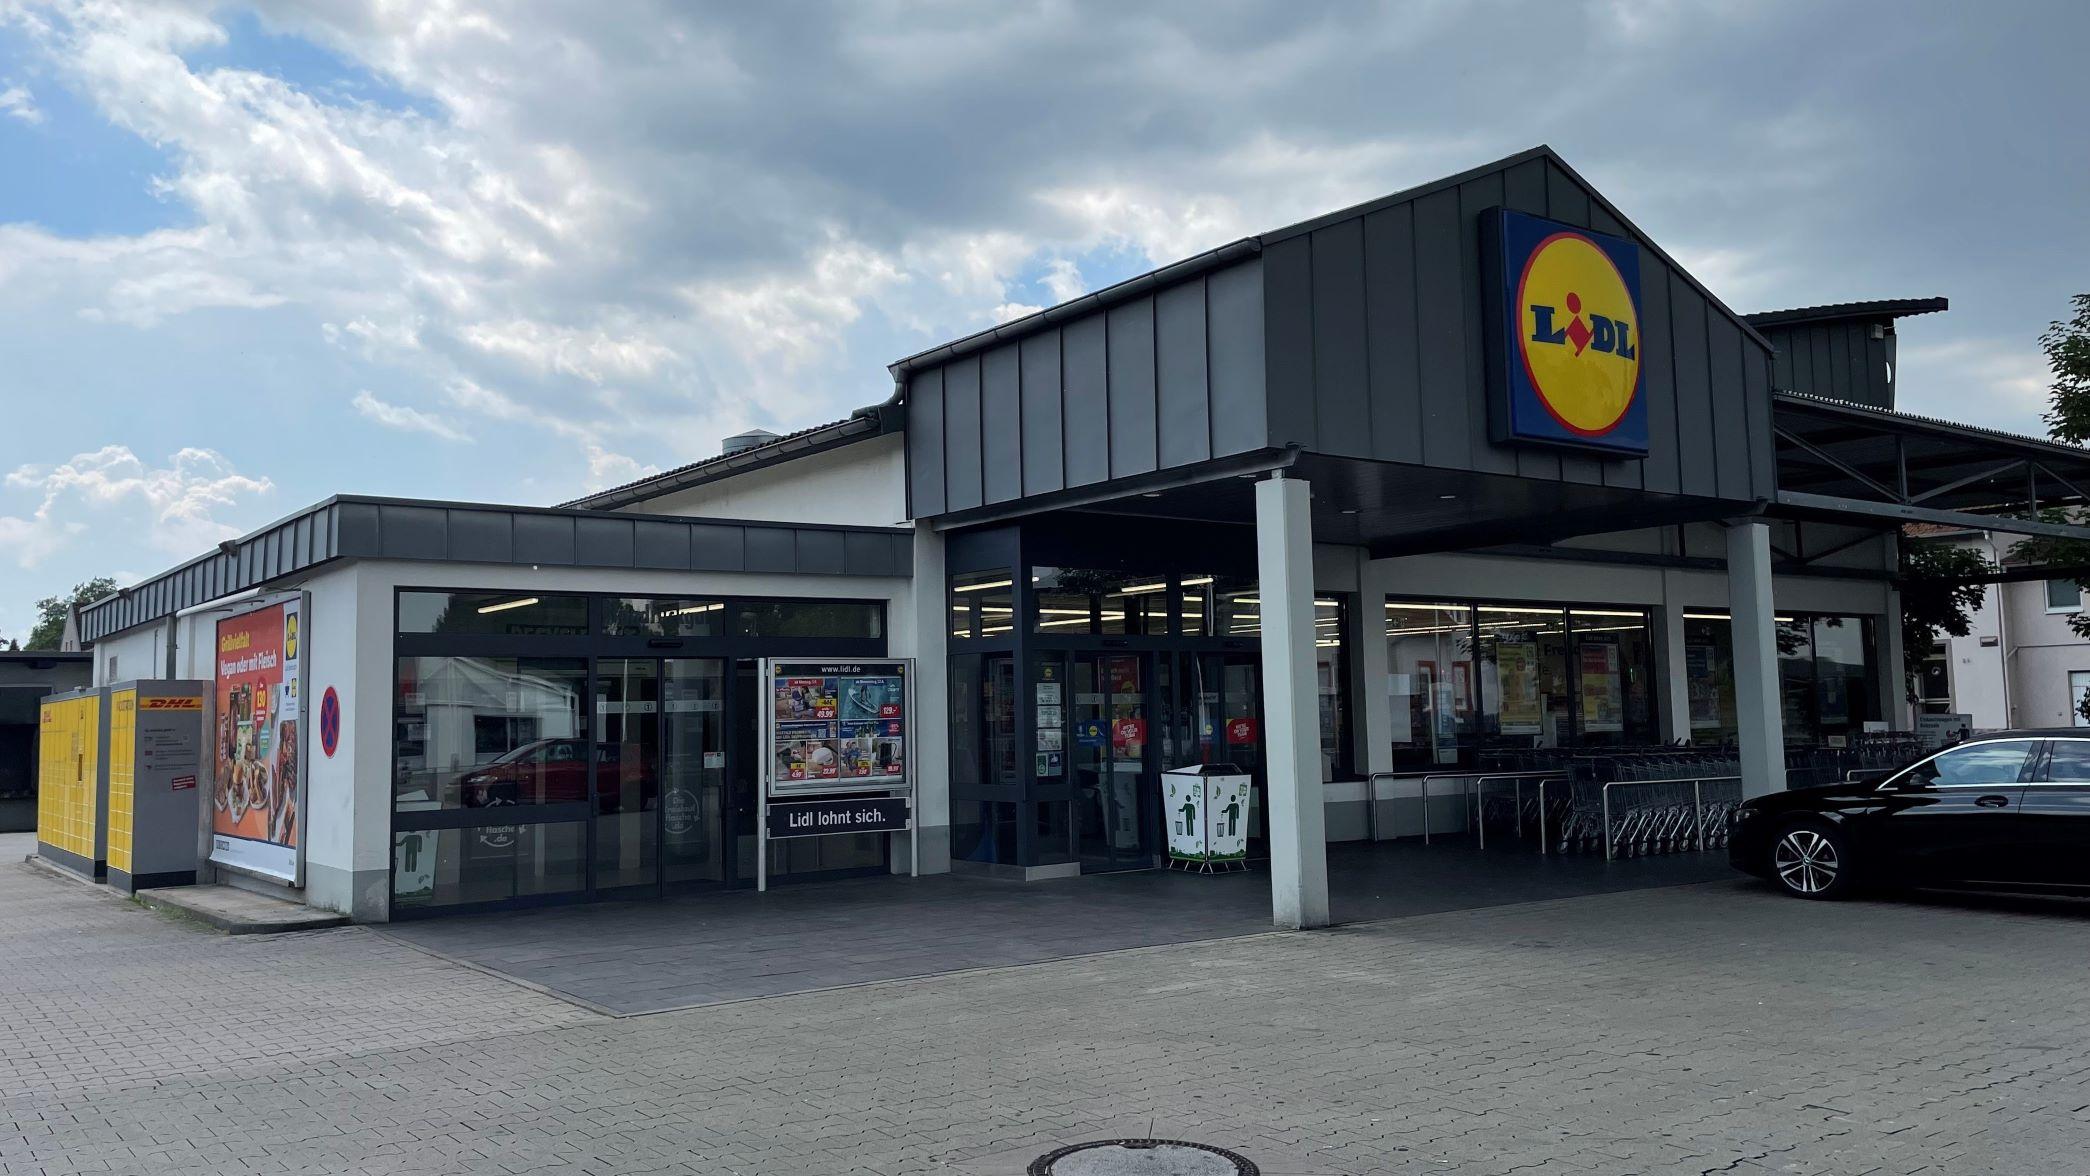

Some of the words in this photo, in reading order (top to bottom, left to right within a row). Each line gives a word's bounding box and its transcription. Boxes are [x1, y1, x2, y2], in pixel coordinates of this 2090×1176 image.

[221, 659, 236, 679] Vegan
[237, 656, 248, 673] oder
[249, 652, 257, 671] mit
[258, 649, 277, 669] Fleisch
[821, 665, 861, 673] www.lidl.de
[149, 699, 195, 709] DHL
[789, 812, 814, 827] Lidl
[818, 810, 851, 826] lohnt
[855, 808, 886, 823] sich.
